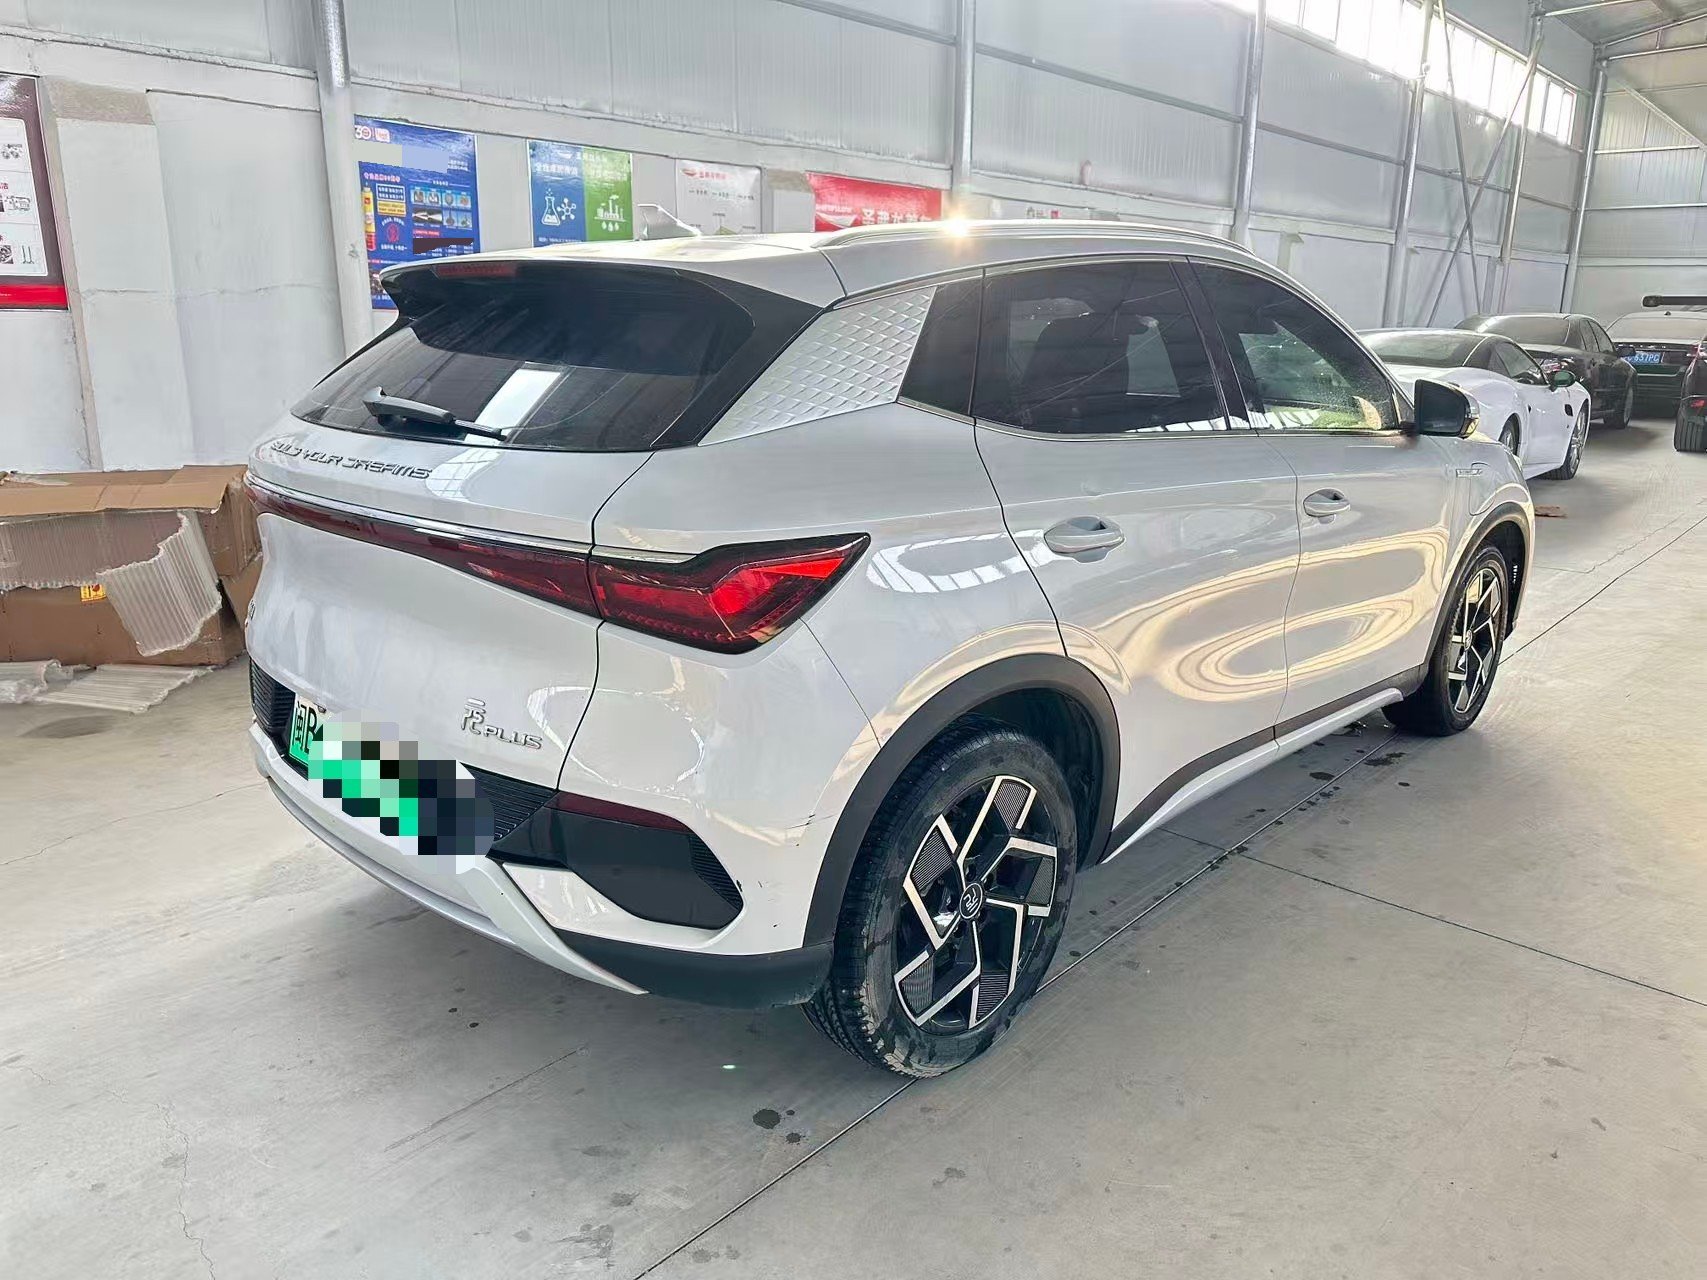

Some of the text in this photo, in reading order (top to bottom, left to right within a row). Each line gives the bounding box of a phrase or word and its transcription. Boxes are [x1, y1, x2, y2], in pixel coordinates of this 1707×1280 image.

[302, 448, 344, 466] YOUR
[342, 457, 433, 480] DREAMS
[292, 700, 323, 755] 闽B
[483, 724, 543, 750] PLUS
